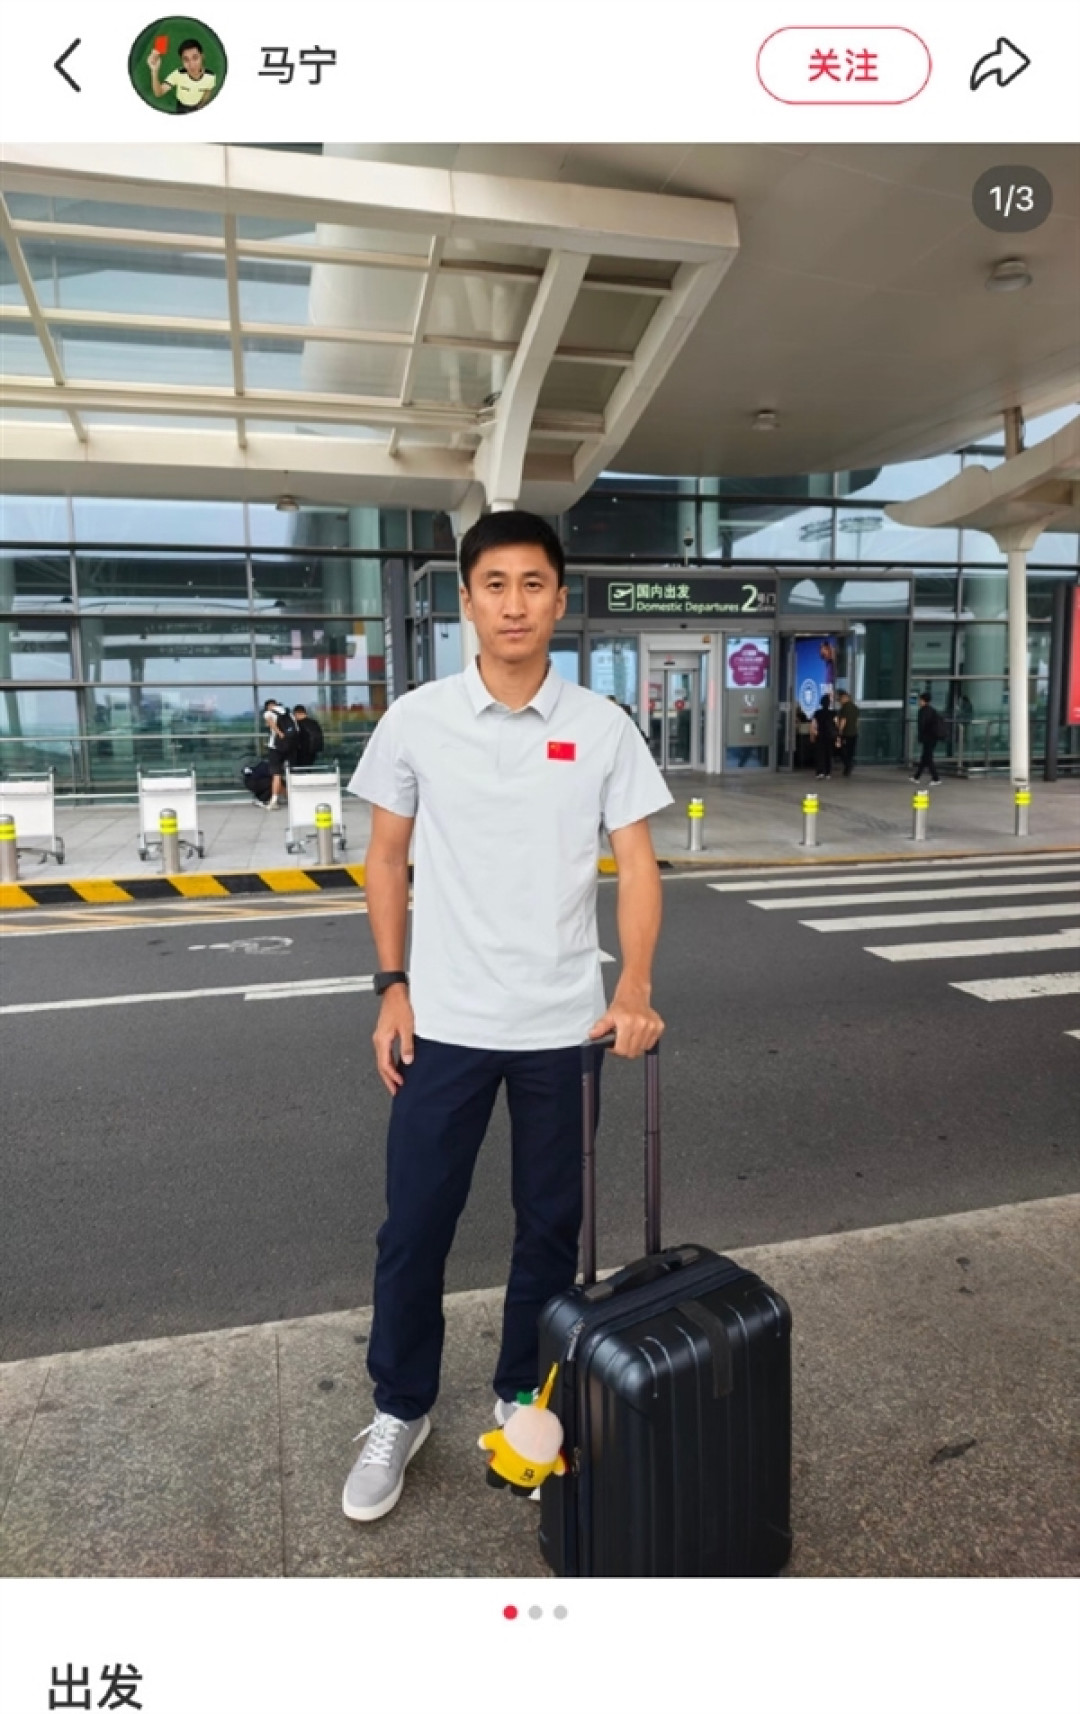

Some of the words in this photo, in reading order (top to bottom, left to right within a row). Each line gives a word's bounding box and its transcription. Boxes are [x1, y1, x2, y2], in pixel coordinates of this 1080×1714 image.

[636, 583, 690, 599] 国内出发
[741, 584, 758, 612] 2
[636, 602, 682, 611] Domestic
[685, 602, 739, 614] Departures
